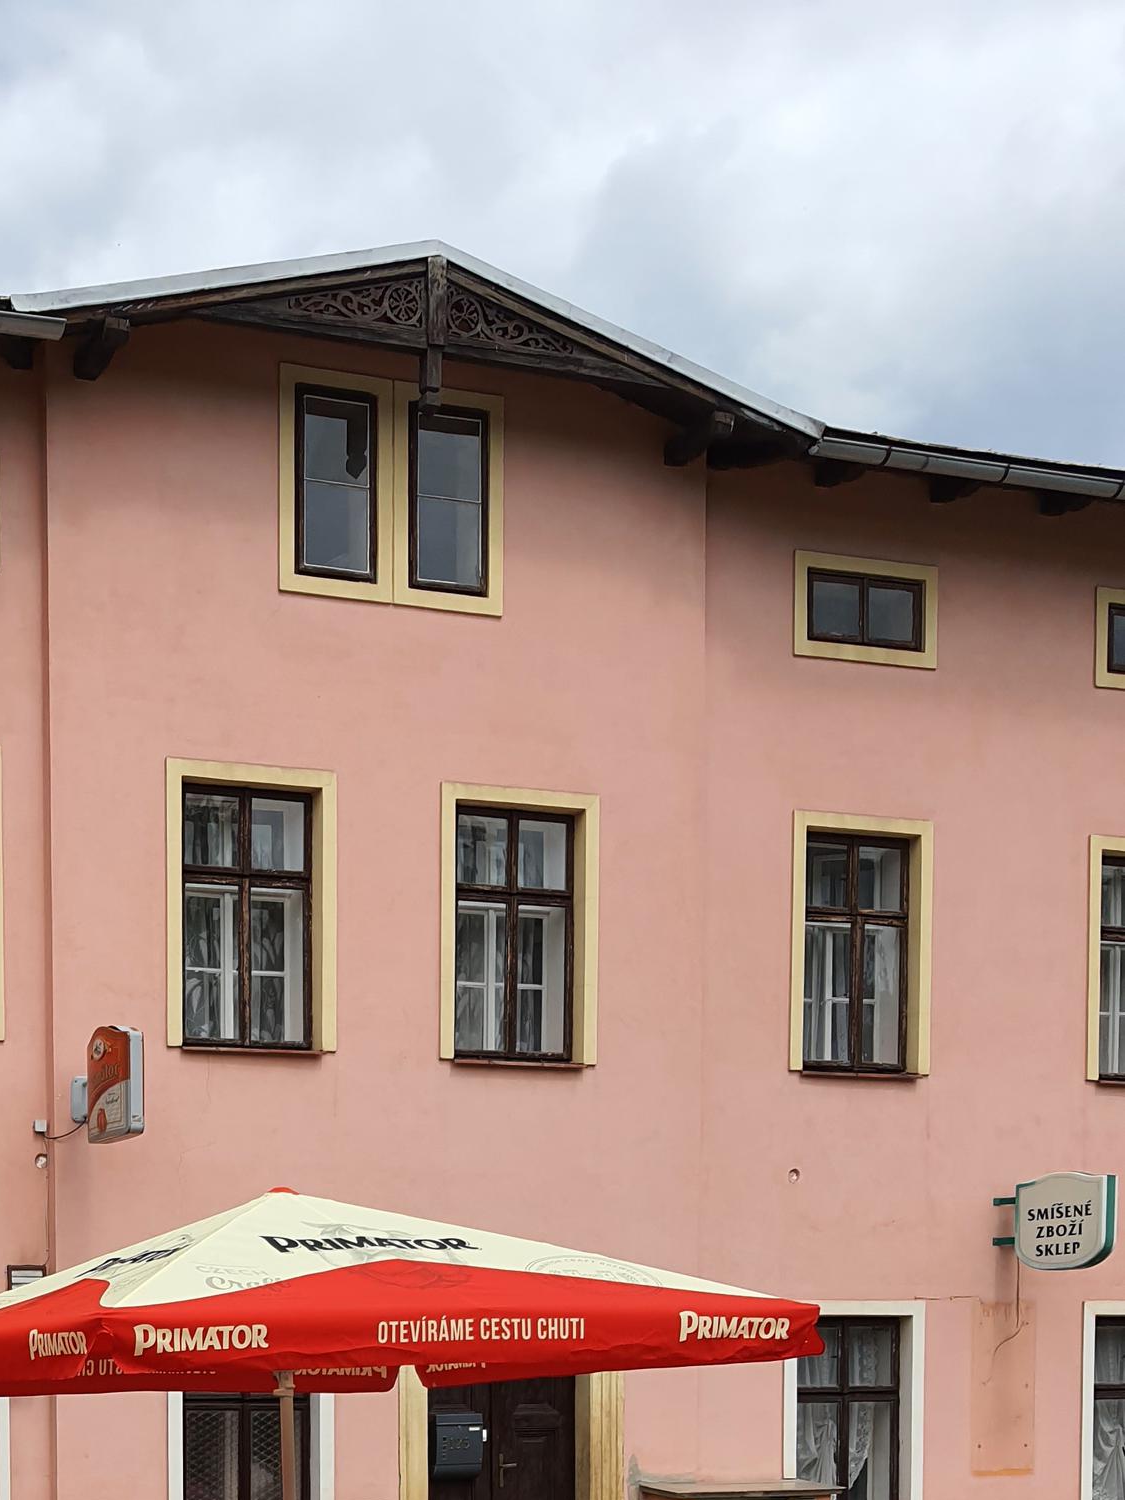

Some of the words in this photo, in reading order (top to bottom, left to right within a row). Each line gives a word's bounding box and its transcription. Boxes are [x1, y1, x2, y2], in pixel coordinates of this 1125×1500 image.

[1027, 1200, 1093, 1221] SMÍŠENÉ
[1036, 1219, 1084, 1238] ZBOŽÍ
[259, 1234, 481, 1253] PRIMATOR
[1036, 1241, 1081, 1256] SKLEP
[378, 1315, 475, 1344] OTEVÍRÁME
[480, 1317, 532, 1340] CESTU
[537, 1317, 585, 1340] CHUTI
[679, 1310, 791, 1343] PRIMATOR
[29, 1329, 88, 1361] PRIMATOR
[133, 1323, 269, 1357] PRIMATOR
